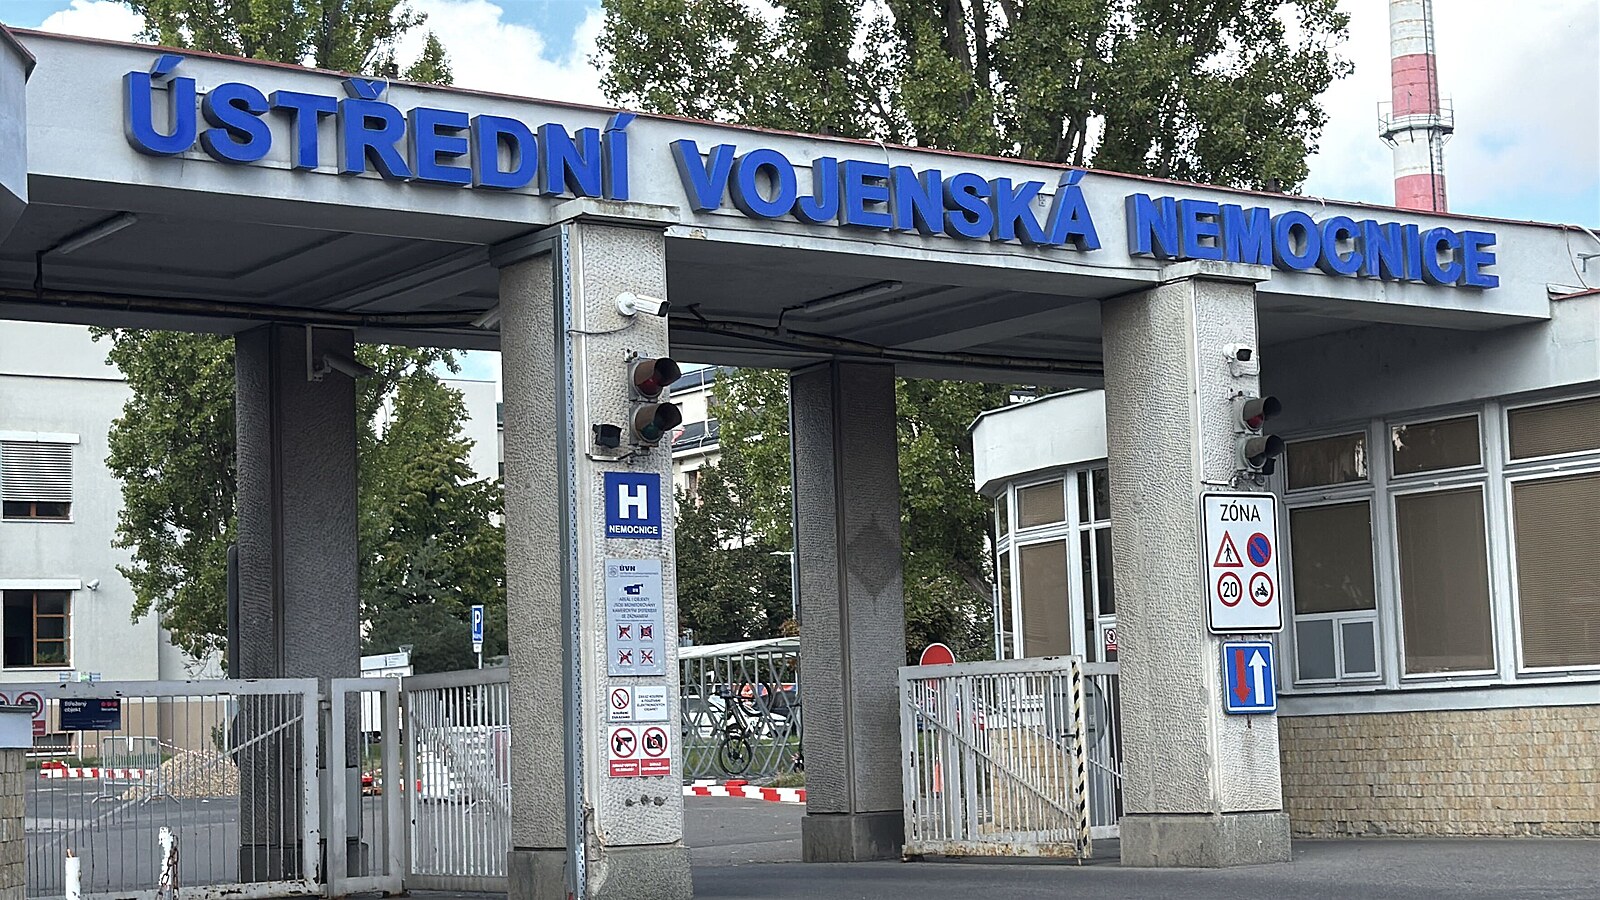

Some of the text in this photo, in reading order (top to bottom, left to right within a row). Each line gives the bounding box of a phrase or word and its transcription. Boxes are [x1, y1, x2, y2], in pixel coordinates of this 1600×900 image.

[123, 54, 1500, 289] ÚSTŘEDNÍ VOJENSKÁ NEMOCNICE
[619, 485, 648, 520] H
[1220, 500, 1261, 522] ZÓNA
[609, 525, 658, 534] NEMOCNICE
[1223, 582, 1238, 597] 20
[474, 610, 481, 632] P
